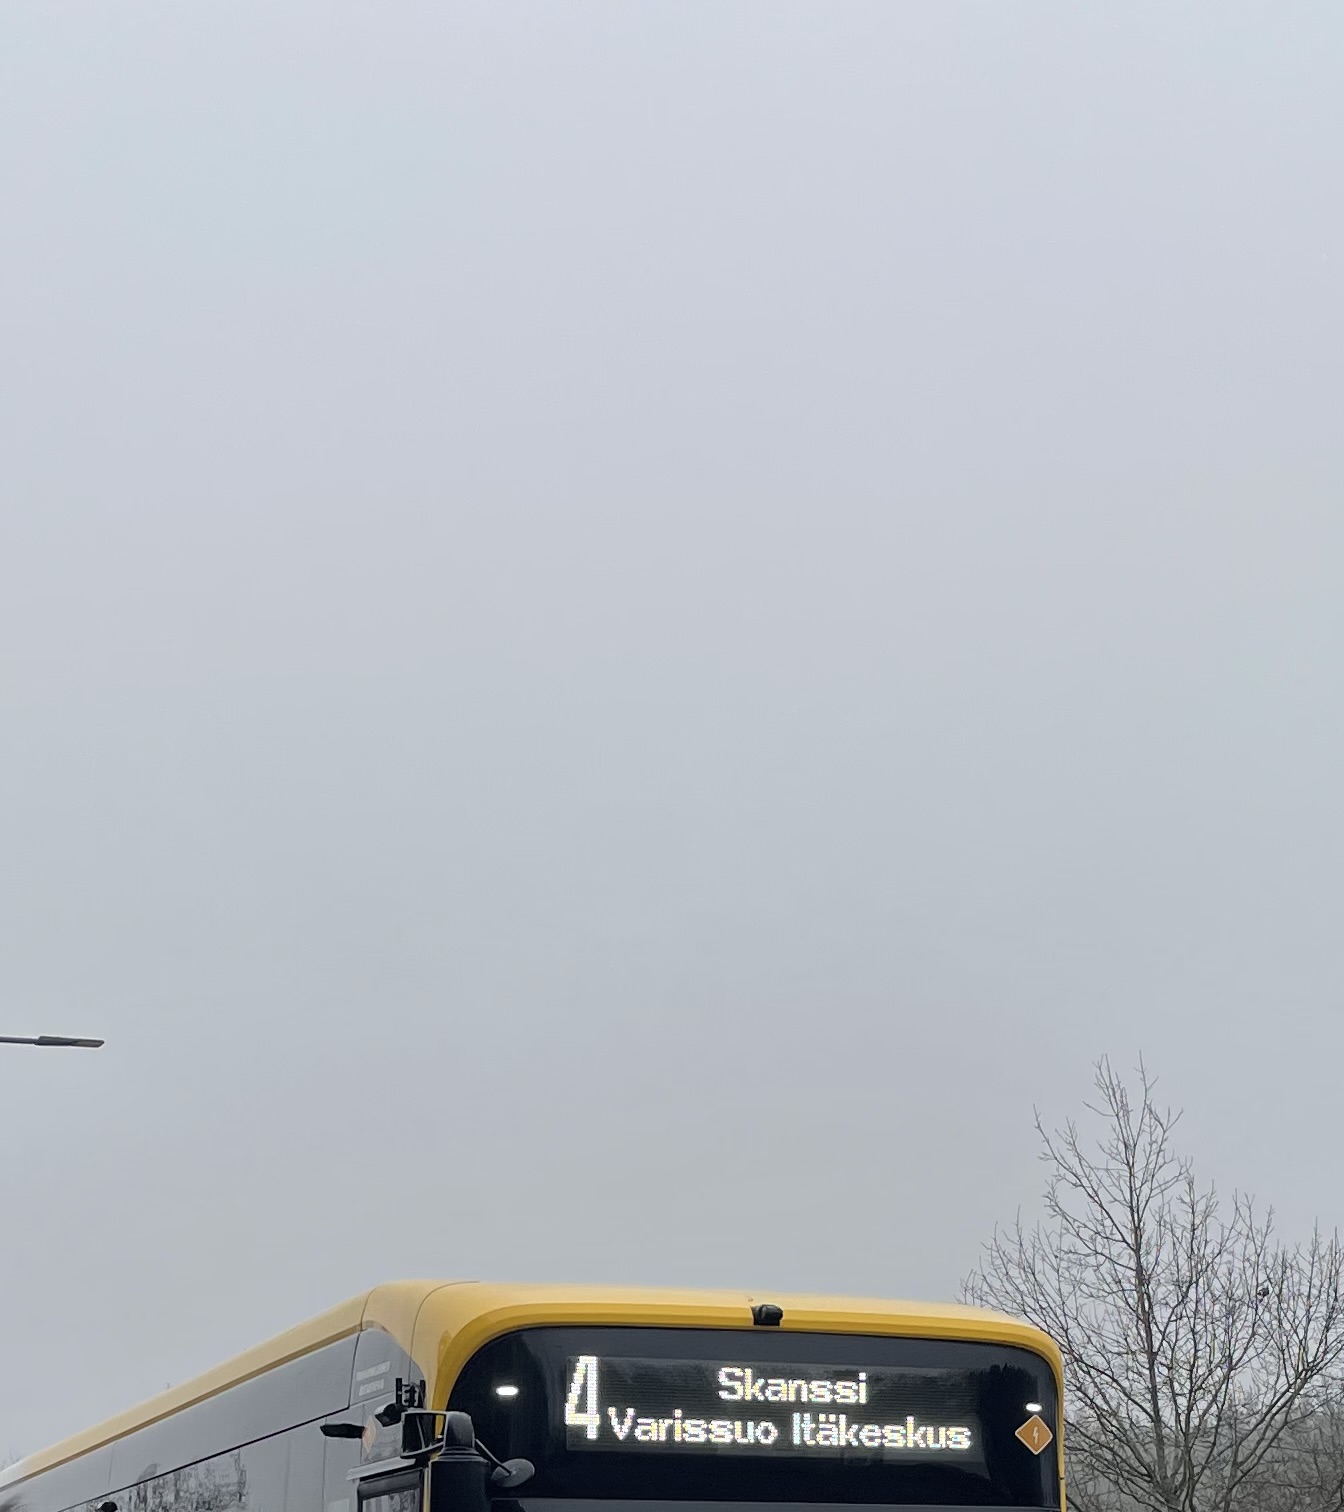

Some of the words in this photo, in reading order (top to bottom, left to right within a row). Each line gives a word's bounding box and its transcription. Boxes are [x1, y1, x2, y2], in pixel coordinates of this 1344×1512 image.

[565, 1355, 600, 1441] 4
[718, 1366, 869, 1404] Skanssi
[607, 1407, 779, 1445] Varissuo
[792, 1412, 972, 1450] Itäkeskus
